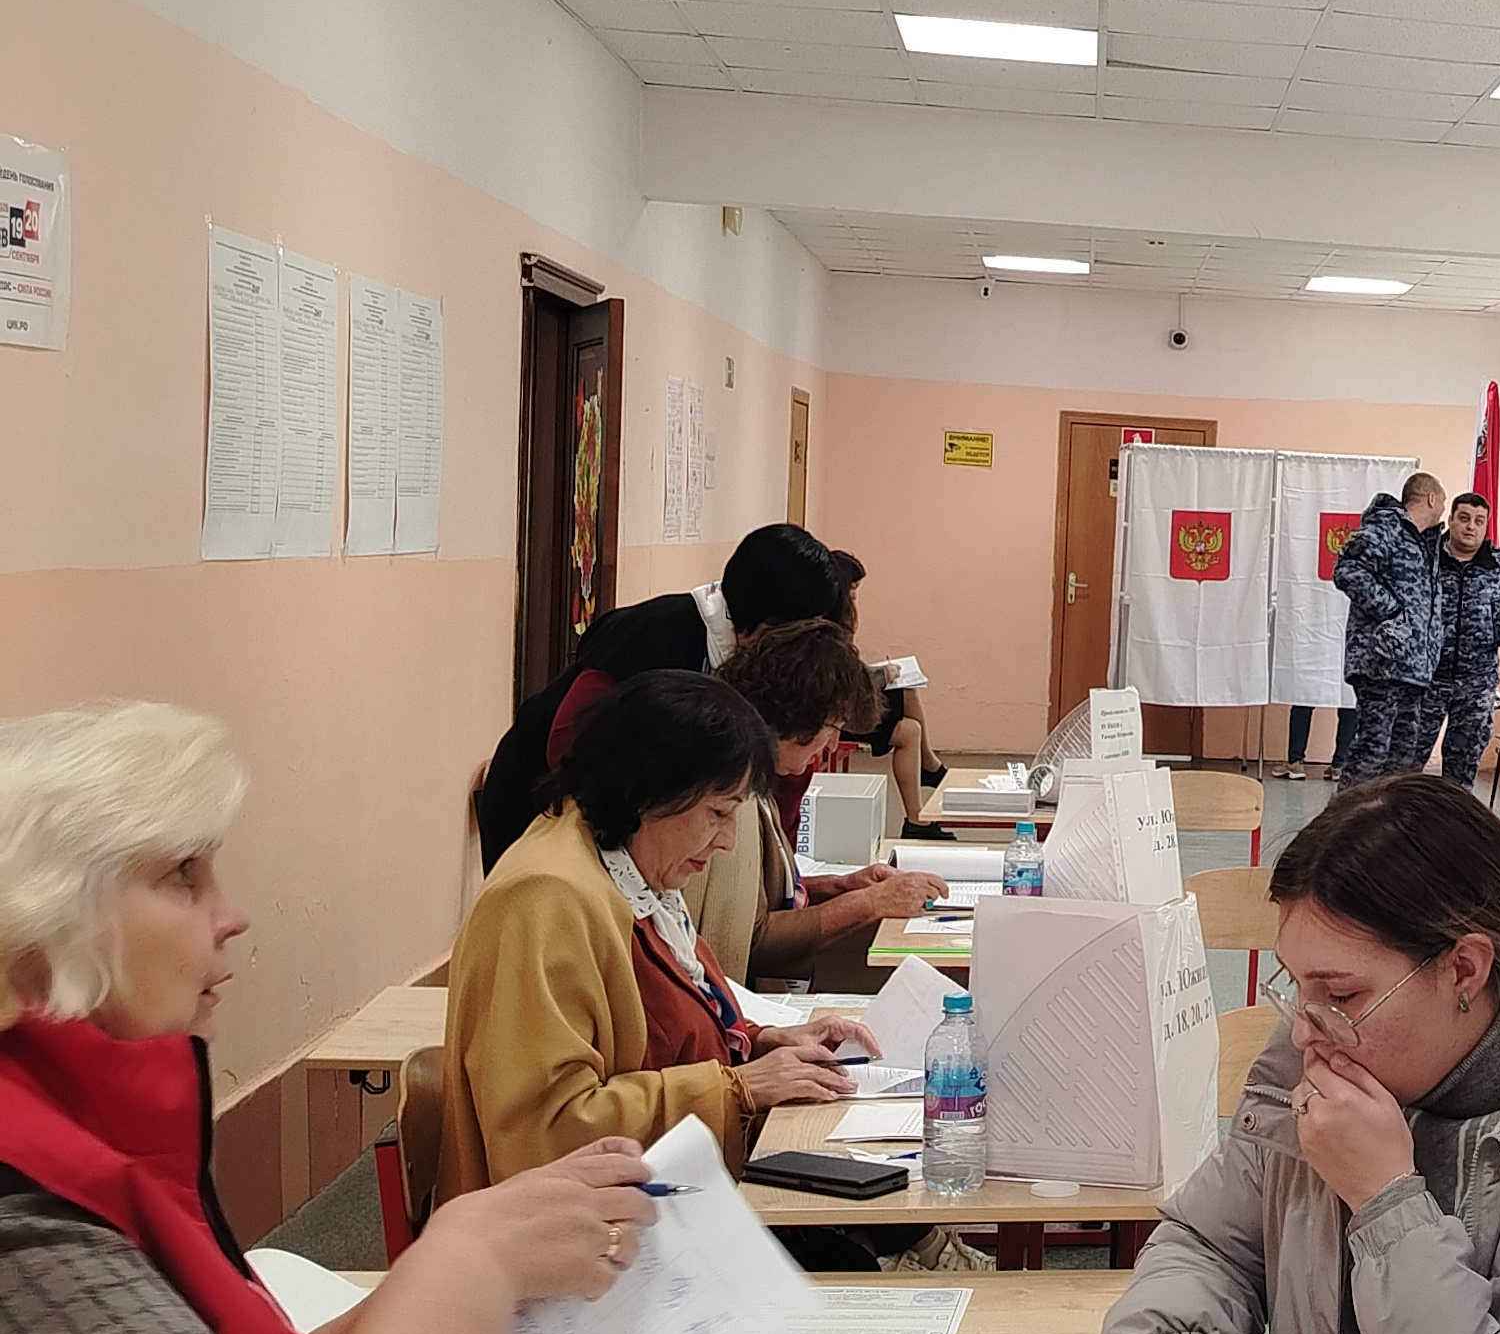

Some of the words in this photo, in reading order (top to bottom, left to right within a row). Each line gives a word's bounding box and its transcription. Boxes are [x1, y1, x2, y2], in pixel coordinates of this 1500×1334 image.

[11, 216, 23, 240] 19
[25, 208, 38, 233] 20
[1137, 815, 1159, 832] ул.
[1160, 809, 1176, 825] Ю
[1152, 840, 1165, 852] д.
[1163, 1022, 1175, 1042] д.
